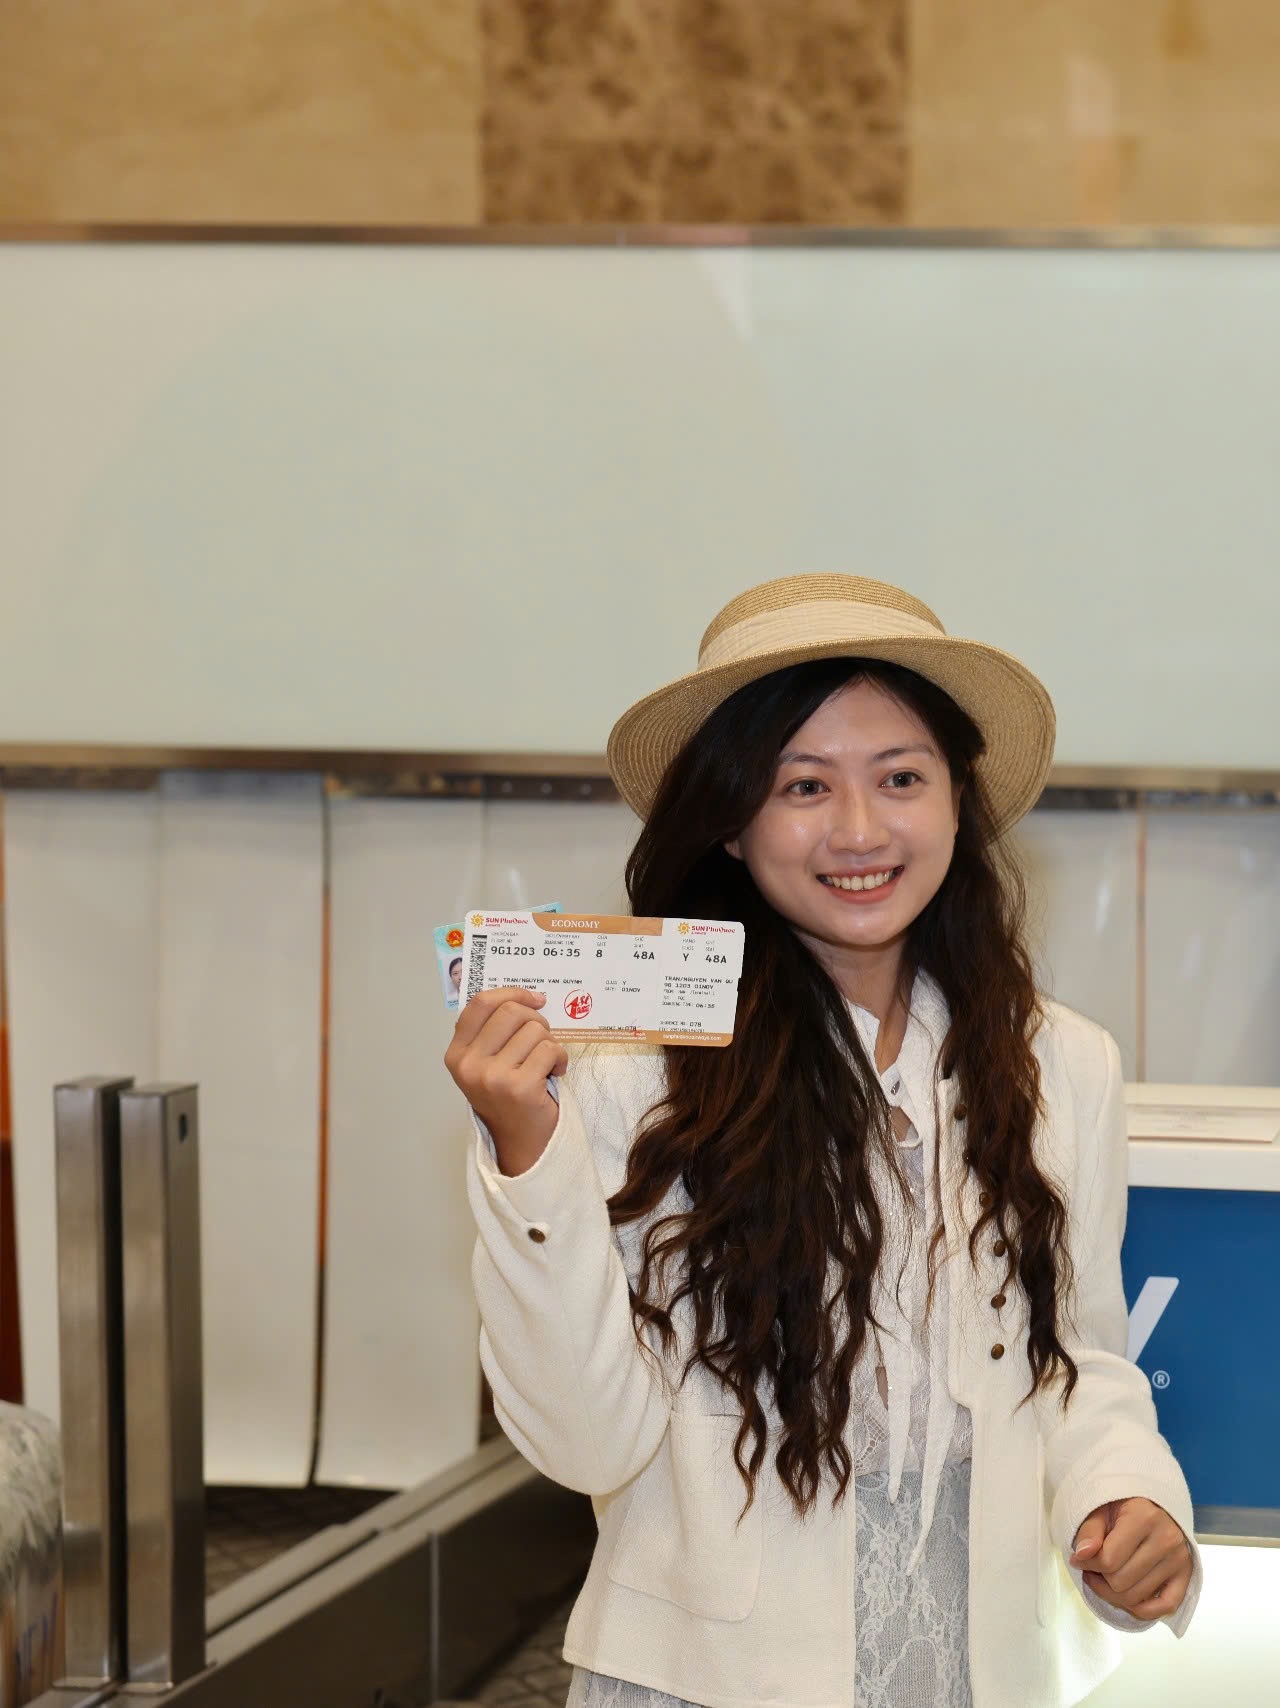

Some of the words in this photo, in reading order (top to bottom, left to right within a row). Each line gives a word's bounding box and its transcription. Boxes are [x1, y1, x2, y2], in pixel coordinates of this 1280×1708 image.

[551, 919, 600, 928] ECONOMY
[491, 946, 535, 956] 9G1203
[543, 947, 581, 958] 06:35
[596, 949, 603, 958] 8
[633, 950, 655, 960] 48A
[683, 953, 690, 962] Y
[705, 954, 727, 964] 48A
